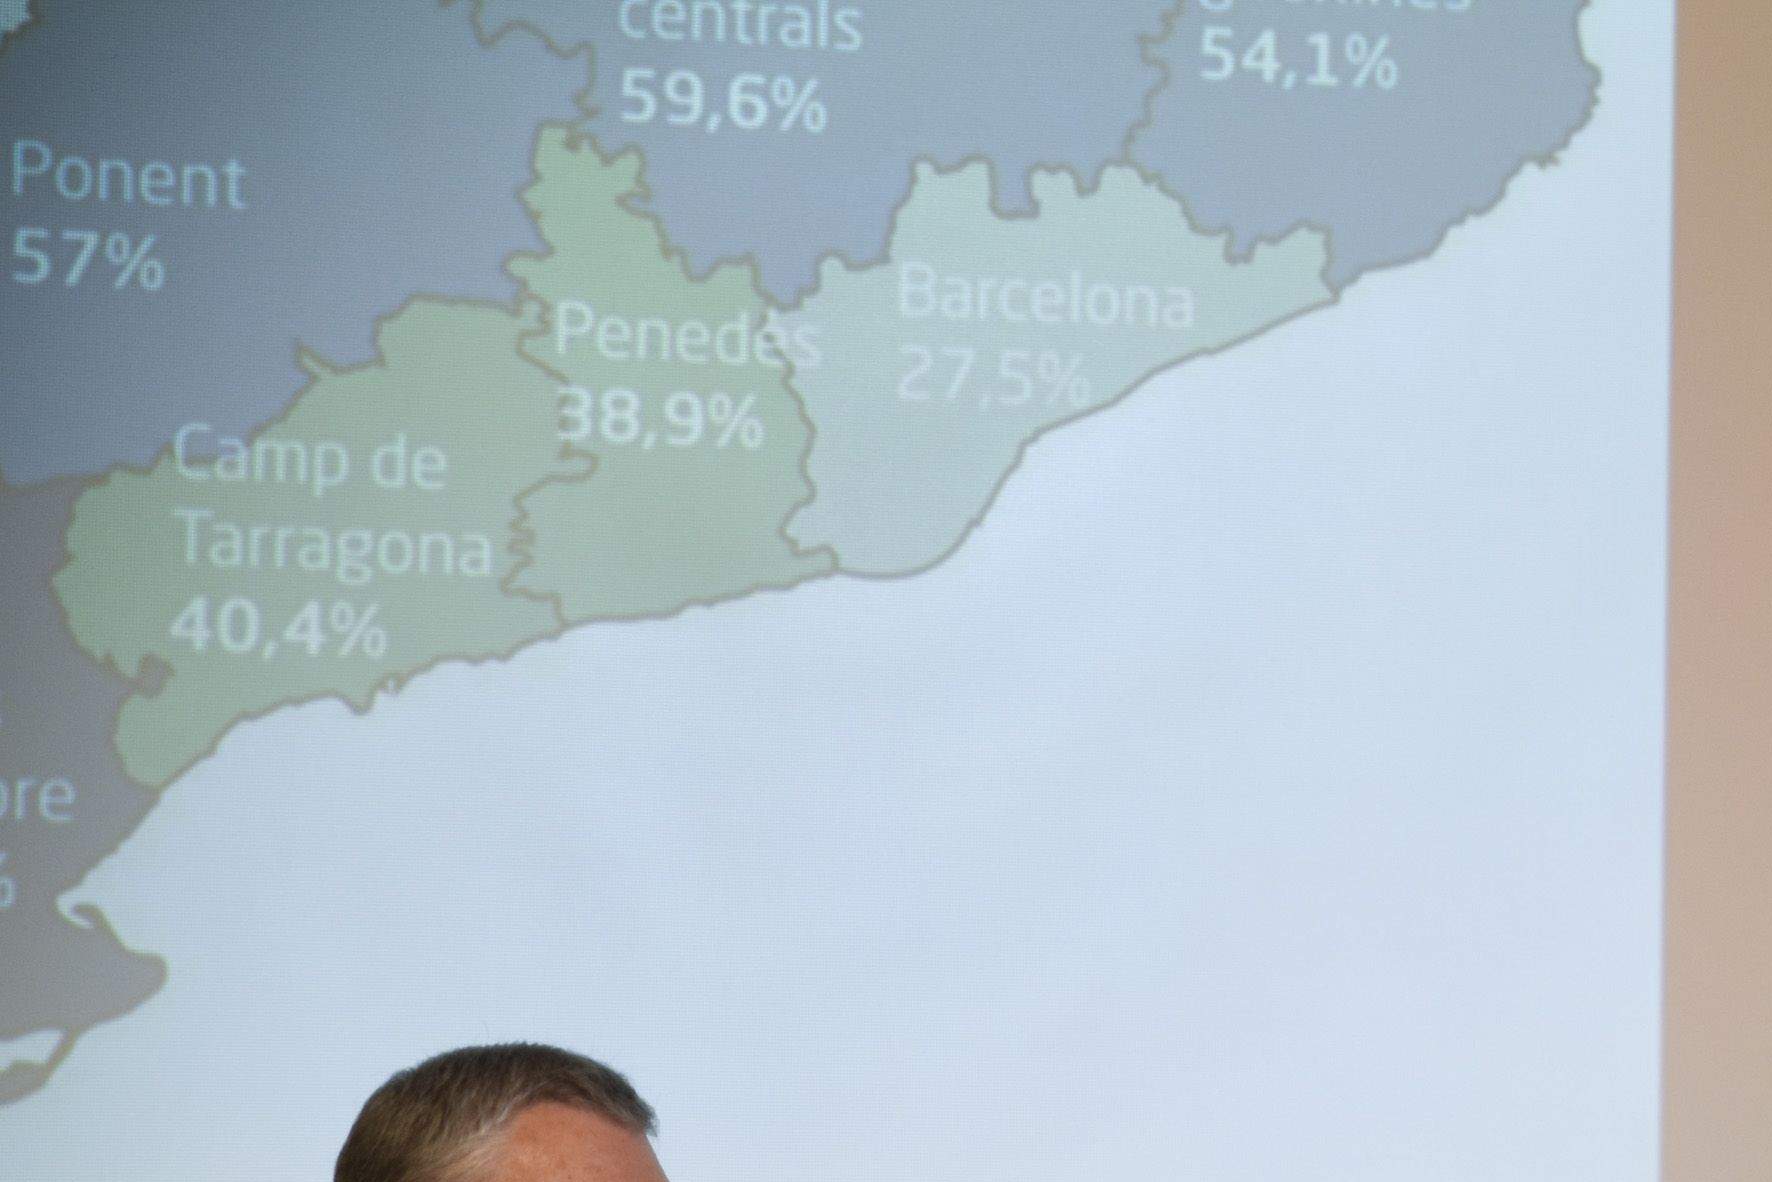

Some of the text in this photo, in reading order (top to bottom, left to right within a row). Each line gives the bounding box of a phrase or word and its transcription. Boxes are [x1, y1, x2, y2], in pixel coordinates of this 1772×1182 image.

[617, 0, 865, 51] centrals
[1200, 24, 1400, 91] 54,1%
[620, 67, 828, 135] 59,6%
[12, 138, 247, 210] Ponent
[12, 227, 167, 292] 57%
[897, 260, 1196, 329] Barcelona
[555, 300, 824, 369] Penedès
[895, 345, 1091, 410] 27,5%
[556, 389, 766, 452] 38,9%
[172, 422, 449, 497] Camp de
[173, 506, 494, 586] Tarragona
[169, 596, 390, 661] 40,4%
